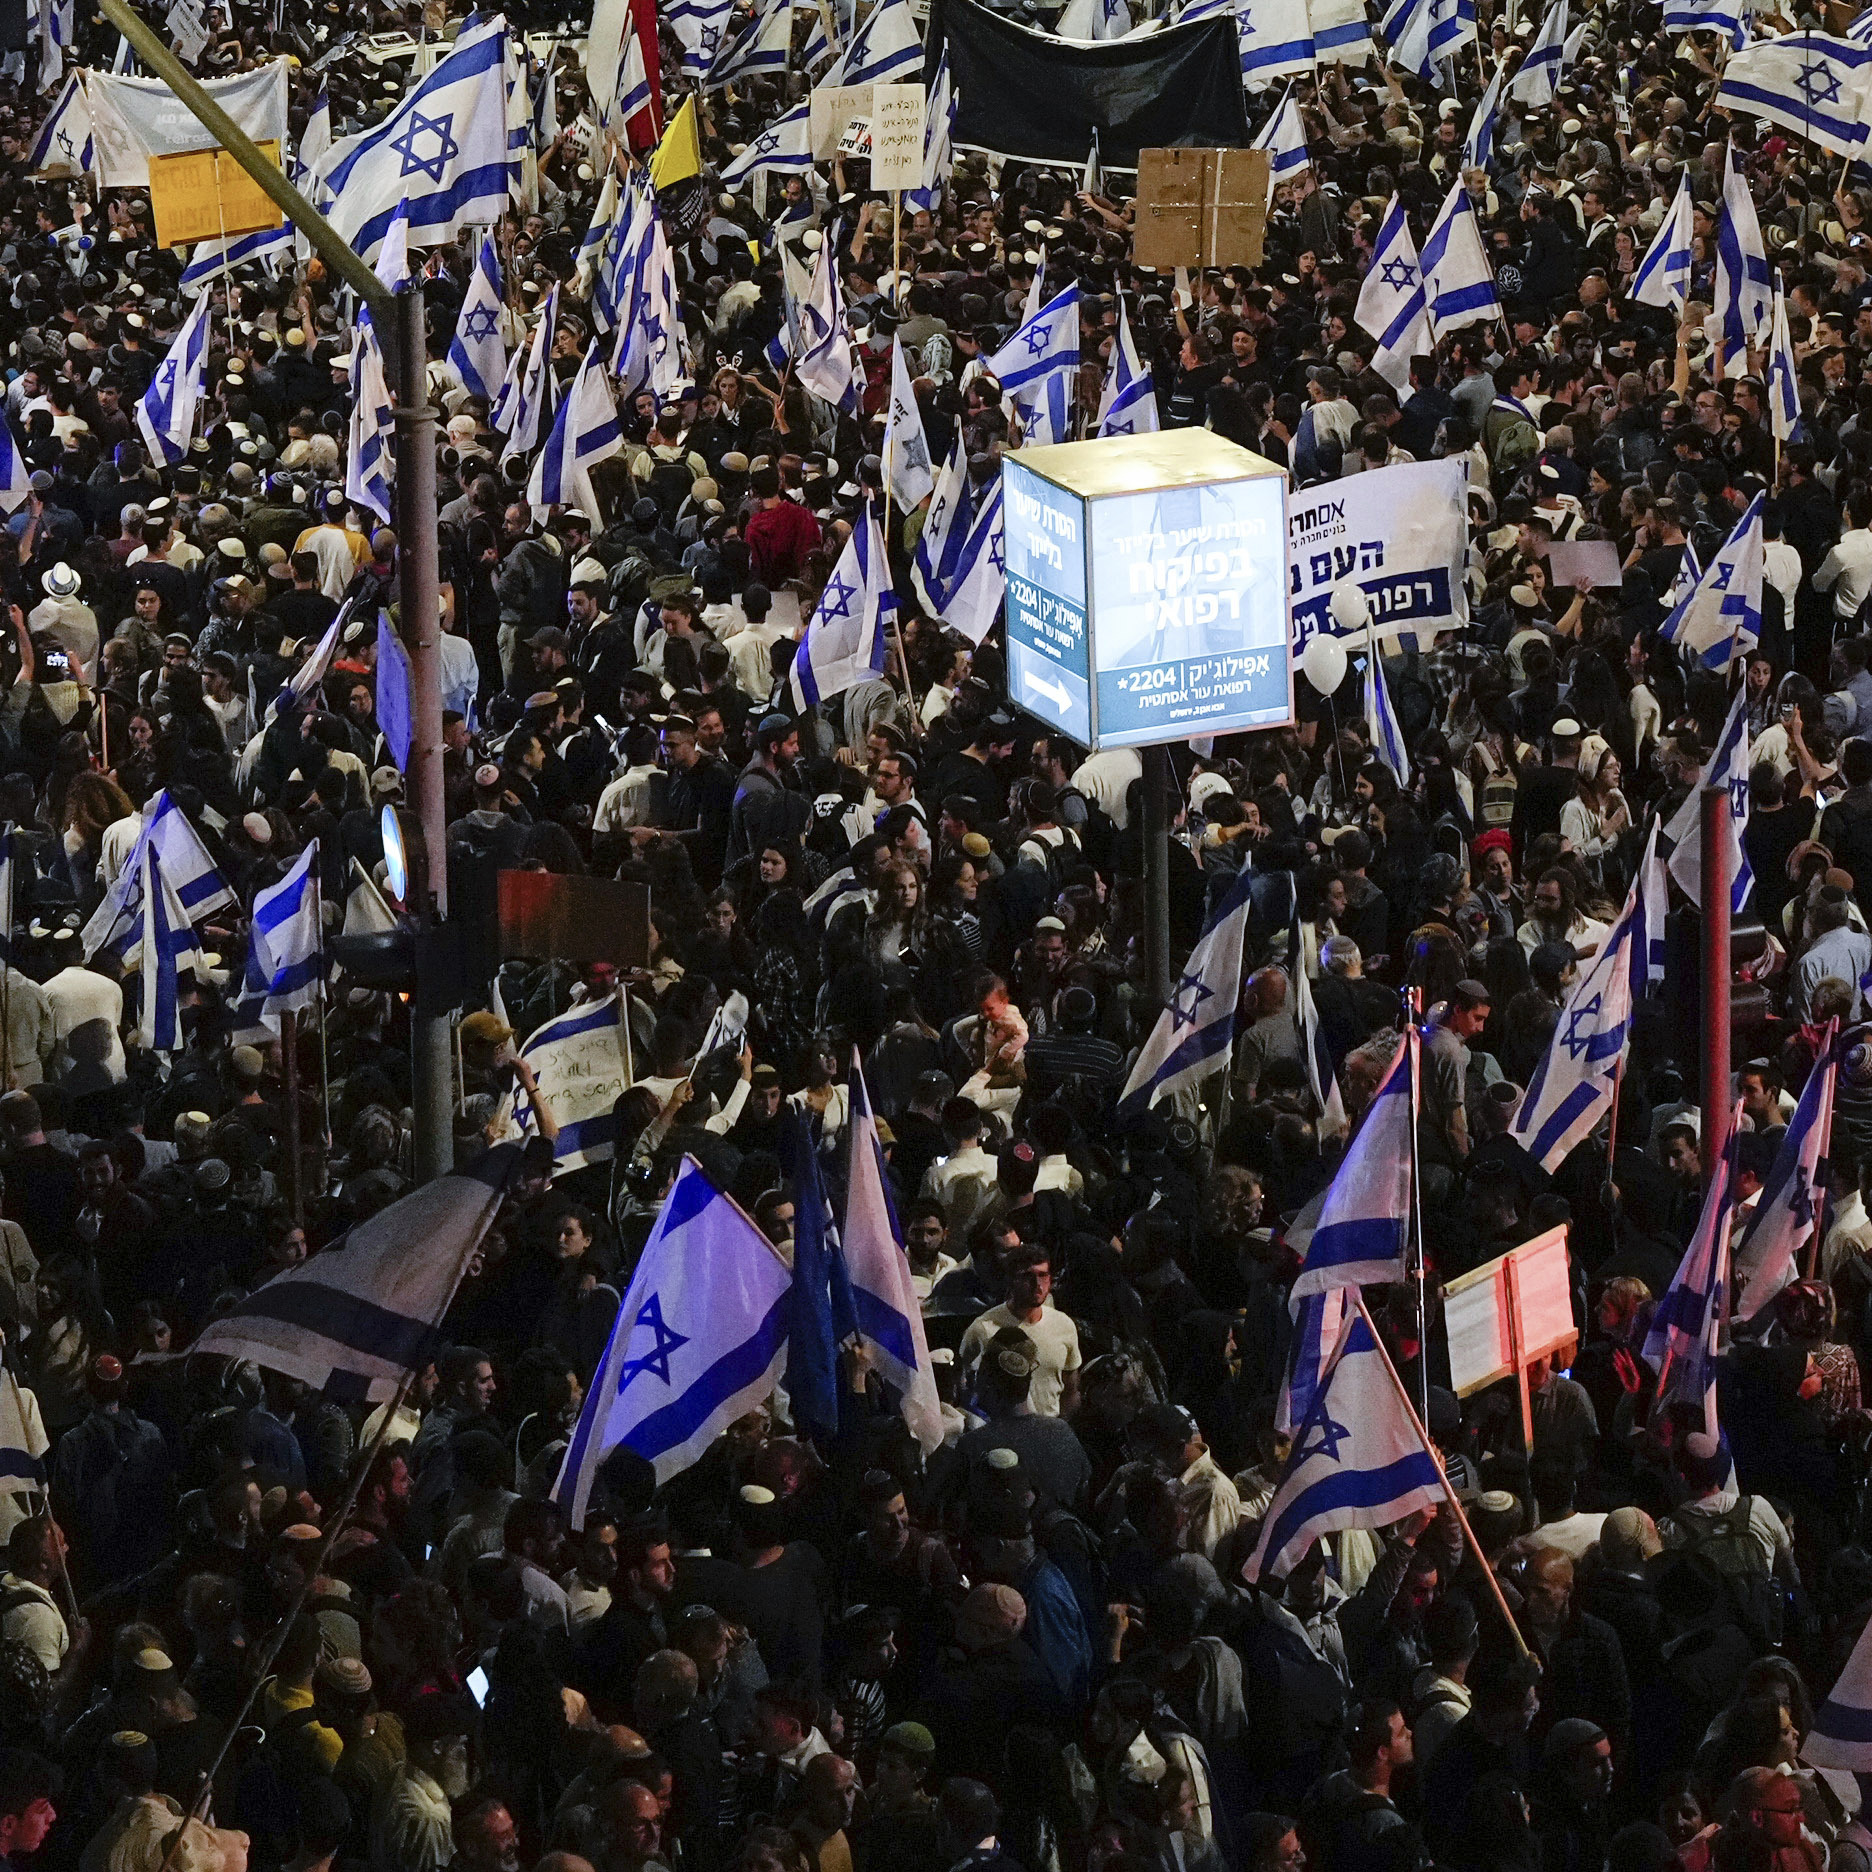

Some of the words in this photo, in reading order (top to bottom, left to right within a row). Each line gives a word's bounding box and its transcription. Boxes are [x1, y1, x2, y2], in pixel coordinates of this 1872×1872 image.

[1013, 490, 1041, 525] שיער
[1042, 503, 1077, 543] הסרת
[1216, 517, 1267, 541] הסרת
[1323, 524, 1347, 539] בונים
[1113, 532, 1167, 555] בלייזר
[1169, 526, 1213, 547] שיער
[1300, 530, 1322, 547] חברה
[1027, 530, 1063, 572] בלייזר
[1129, 547, 1255, 598] בפיקוח
[1309, 540, 1384, 587] העם
[1020, 609, 1043, 633] אסתטית
[1144, 588, 1240, 632] רפואי
[1043, 623, 1055, 636] עור
[1054, 627, 1075, 651] רפואת
[1138, 690, 1189, 709] אסתטית
[1191, 686, 1211, 699] עור
[1212, 679, 1252, 697] רפואת
